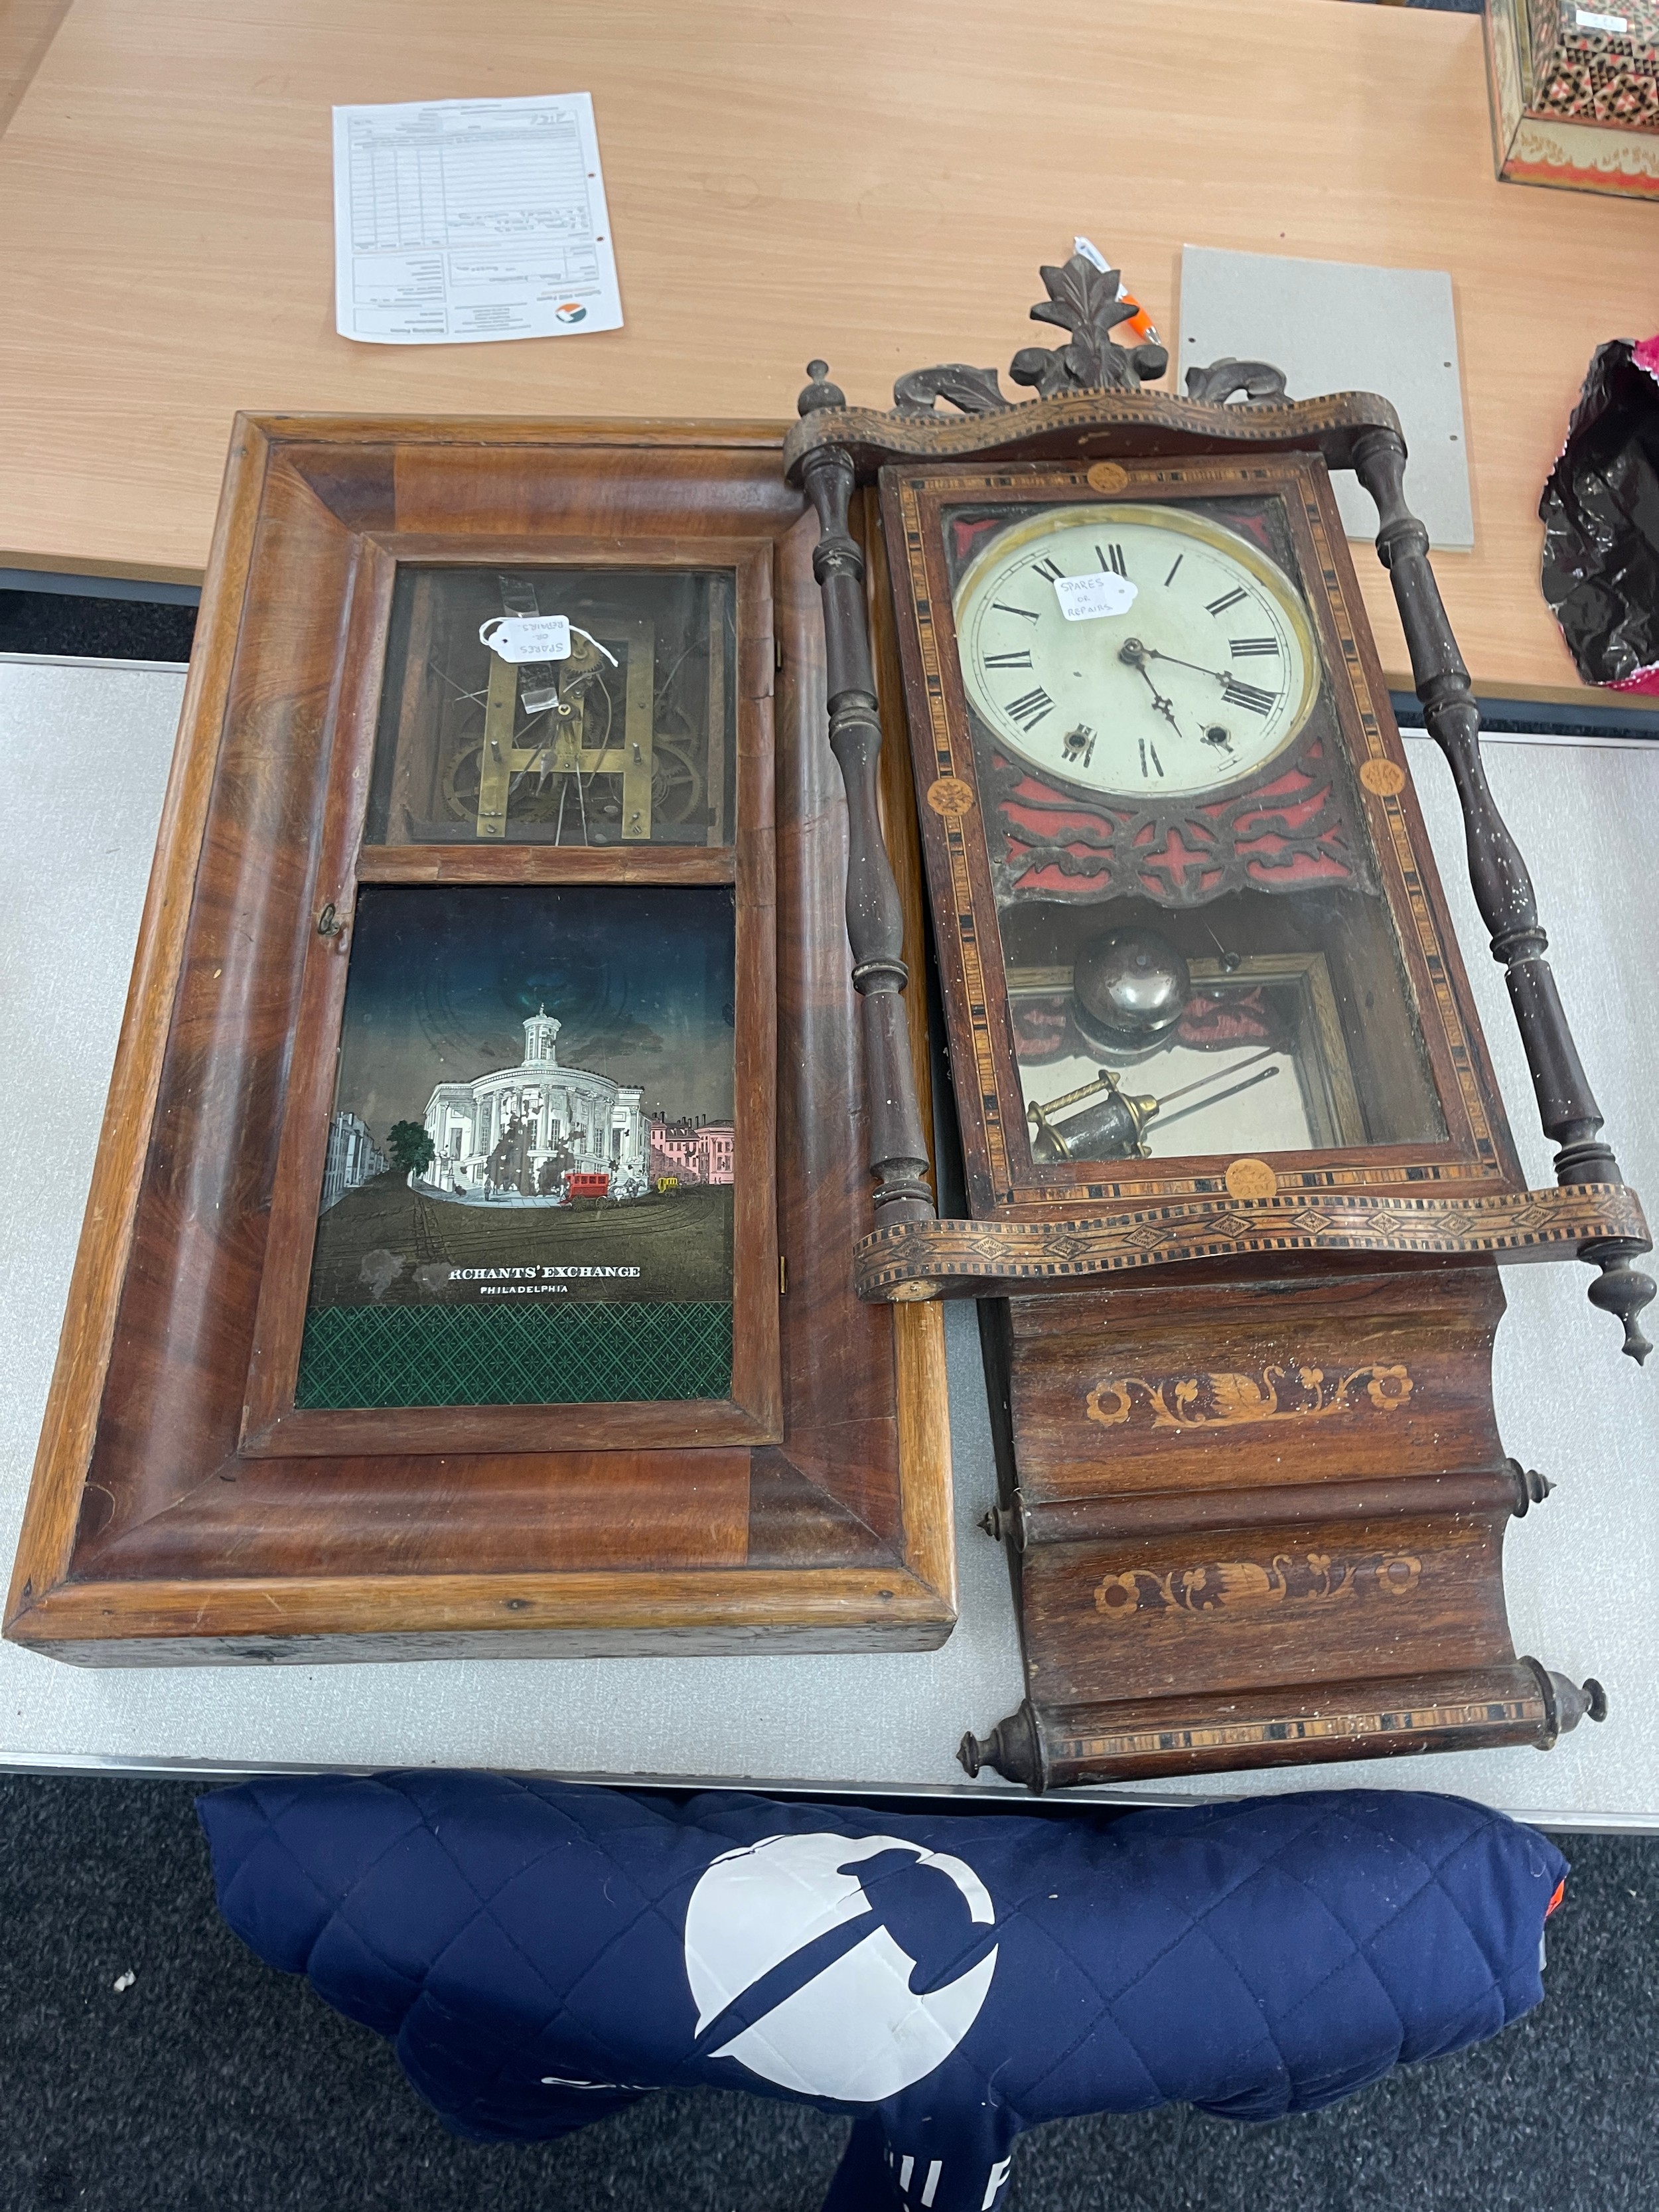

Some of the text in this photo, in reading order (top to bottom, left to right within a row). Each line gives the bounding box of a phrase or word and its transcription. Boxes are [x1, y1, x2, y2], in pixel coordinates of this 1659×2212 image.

[1060, 579, 1104, 591] SPARES
[520, 643, 563, 654] SPARES
[423, 1265, 640, 1281] RCHANTS' EXCHANGE
[480, 1285, 568, 1295] PHILADELPHIA
